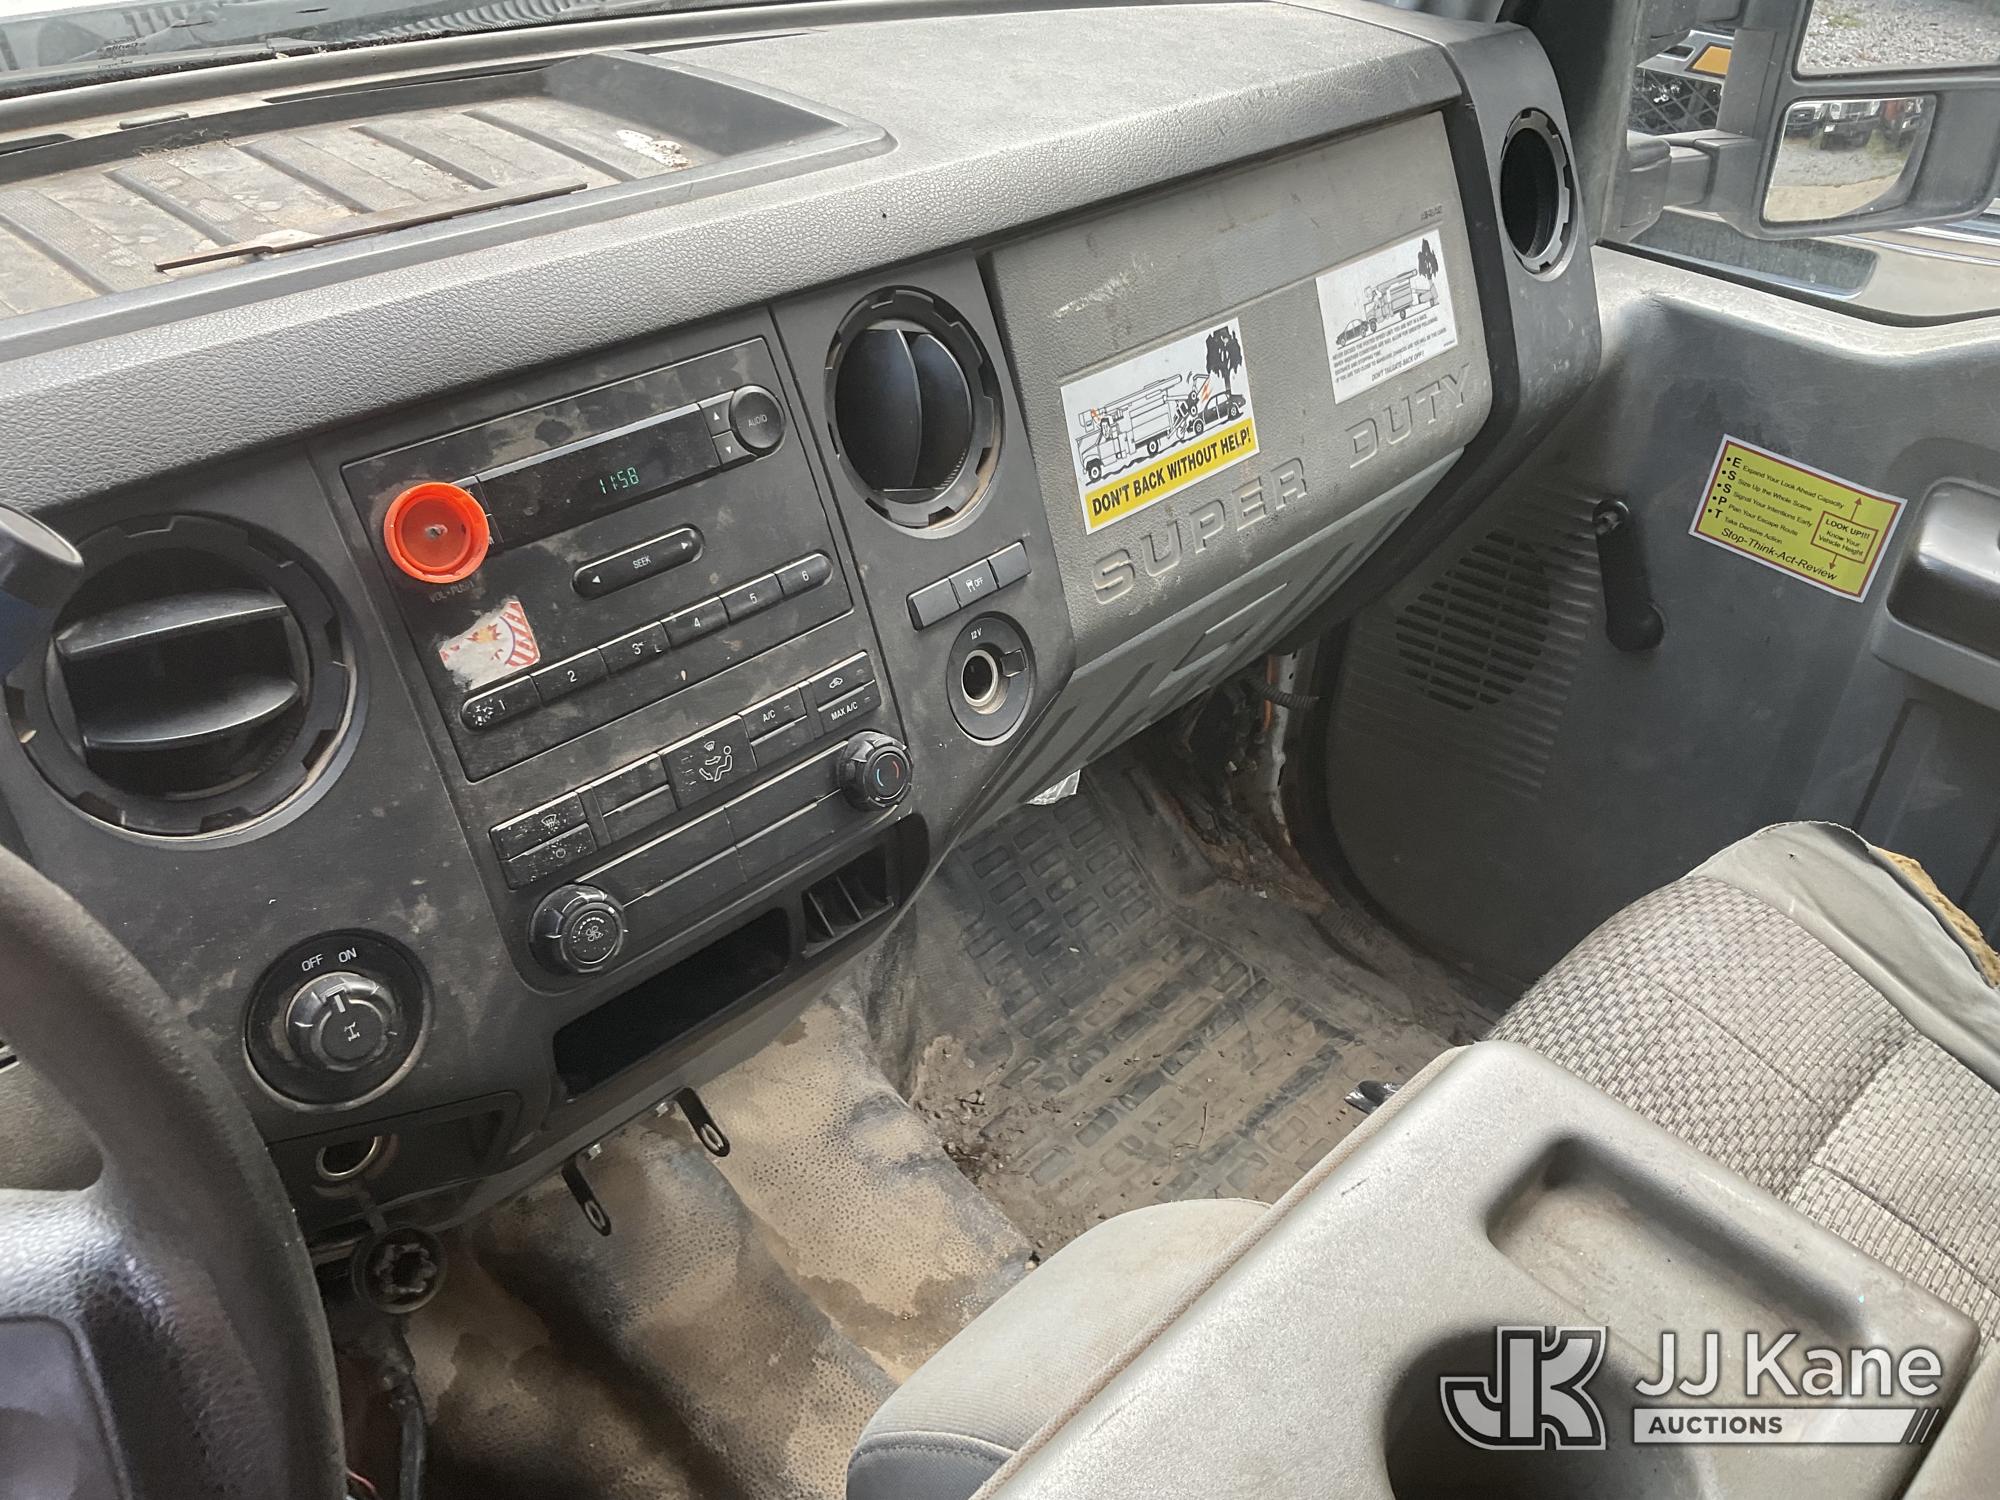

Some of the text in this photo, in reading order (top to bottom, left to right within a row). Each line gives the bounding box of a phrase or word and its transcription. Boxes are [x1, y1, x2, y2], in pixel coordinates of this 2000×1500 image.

[748, 414, 768, 428] AUDIO
[1092, 427, 1251, 516] DON'T BACK WITHOUT HELP!
[1731, 456, 1742, 468] E
[1741, 465, 1765, 479] Expand
[1765, 474, 1780, 484] Your
[1795, 485, 1817, 498] Ahead
[599, 467, 640, 495] 11:58
[1092, 363, 1471, 606] SUPER DUTY
[1721, 482, 1732, 494] S
[1726, 469, 1737, 481] S
[1772, 492, 1792, 503] Whole
[1717, 495, 1728, 507] P
[1713, 508, 1723, 519] T
[1825, 518, 1849, 532] LOOK
[1818, 534, 1841, 548] Vehicle
[1825, 530, 1860, 547] Know Your
[1720, 526, 1838, 582] Stop-Think-Act-Review
[632, 555, 651, 570] SEEK
[801, 569, 809, 582] 6
[974, 576, 984, 587] OFF
[749, 592, 758, 605] 5
[693, 616, 702, 630] 4
[631, 642, 641, 655] 3
[567, 669, 578, 682] 2
[498, 699, 506, 711] 1
[831, 700, 859, 721] MAX A/C
[762, 709, 776, 723] A/C
[301, 947, 357, 972] OFF ON
